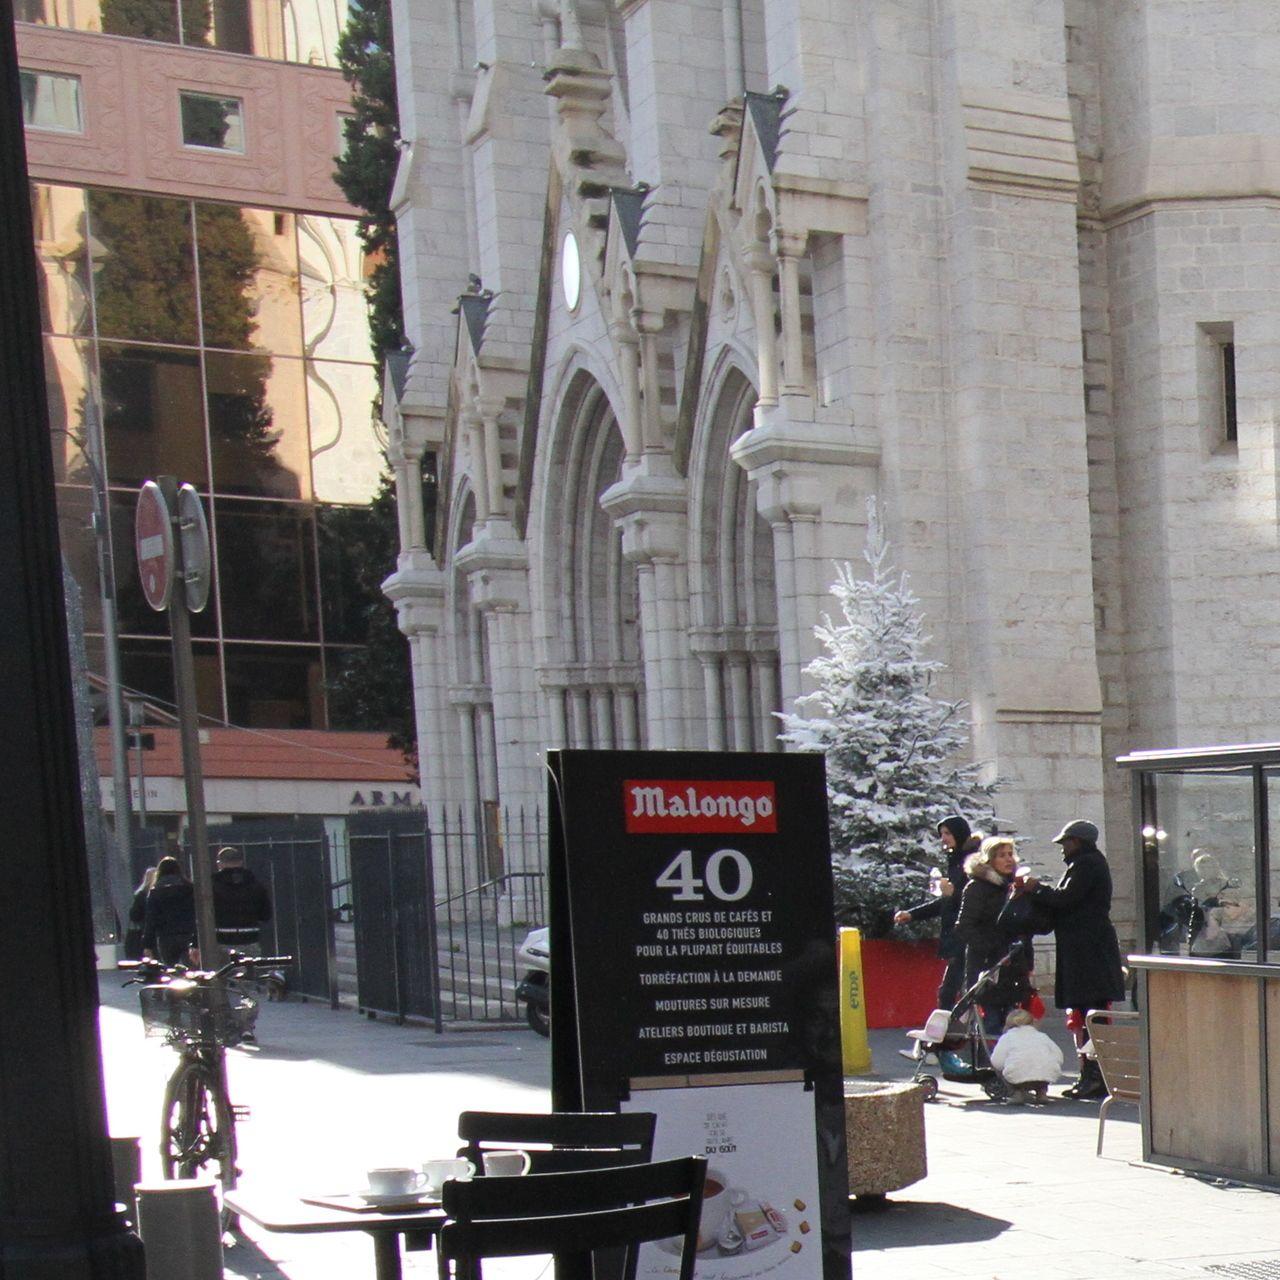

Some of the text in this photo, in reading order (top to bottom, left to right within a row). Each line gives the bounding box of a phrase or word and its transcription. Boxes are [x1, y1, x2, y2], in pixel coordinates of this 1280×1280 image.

[631, 786, 773, 826] Malongo
[656, 849, 753, 901] 40
[643, 909, 773, 924] GRANDS CRUS DE CAFÉS ET
[656, 927, 761, 940] 40 THÉS BIOLOGIQUES
[636, 941, 783, 957] POUR LA PLUPART ÉQUITABLES
[639, 969, 782, 985] TORRÉFACTION À LA DEMANDE
[655, 996, 770, 1011] MOUTURES SUR MESURE
[639, 1022, 790, 1039] ATELIERS BOUTIQUE ET BARISTA
[664, 1048, 767, 1065] ESPACE DÉGUSTATION
